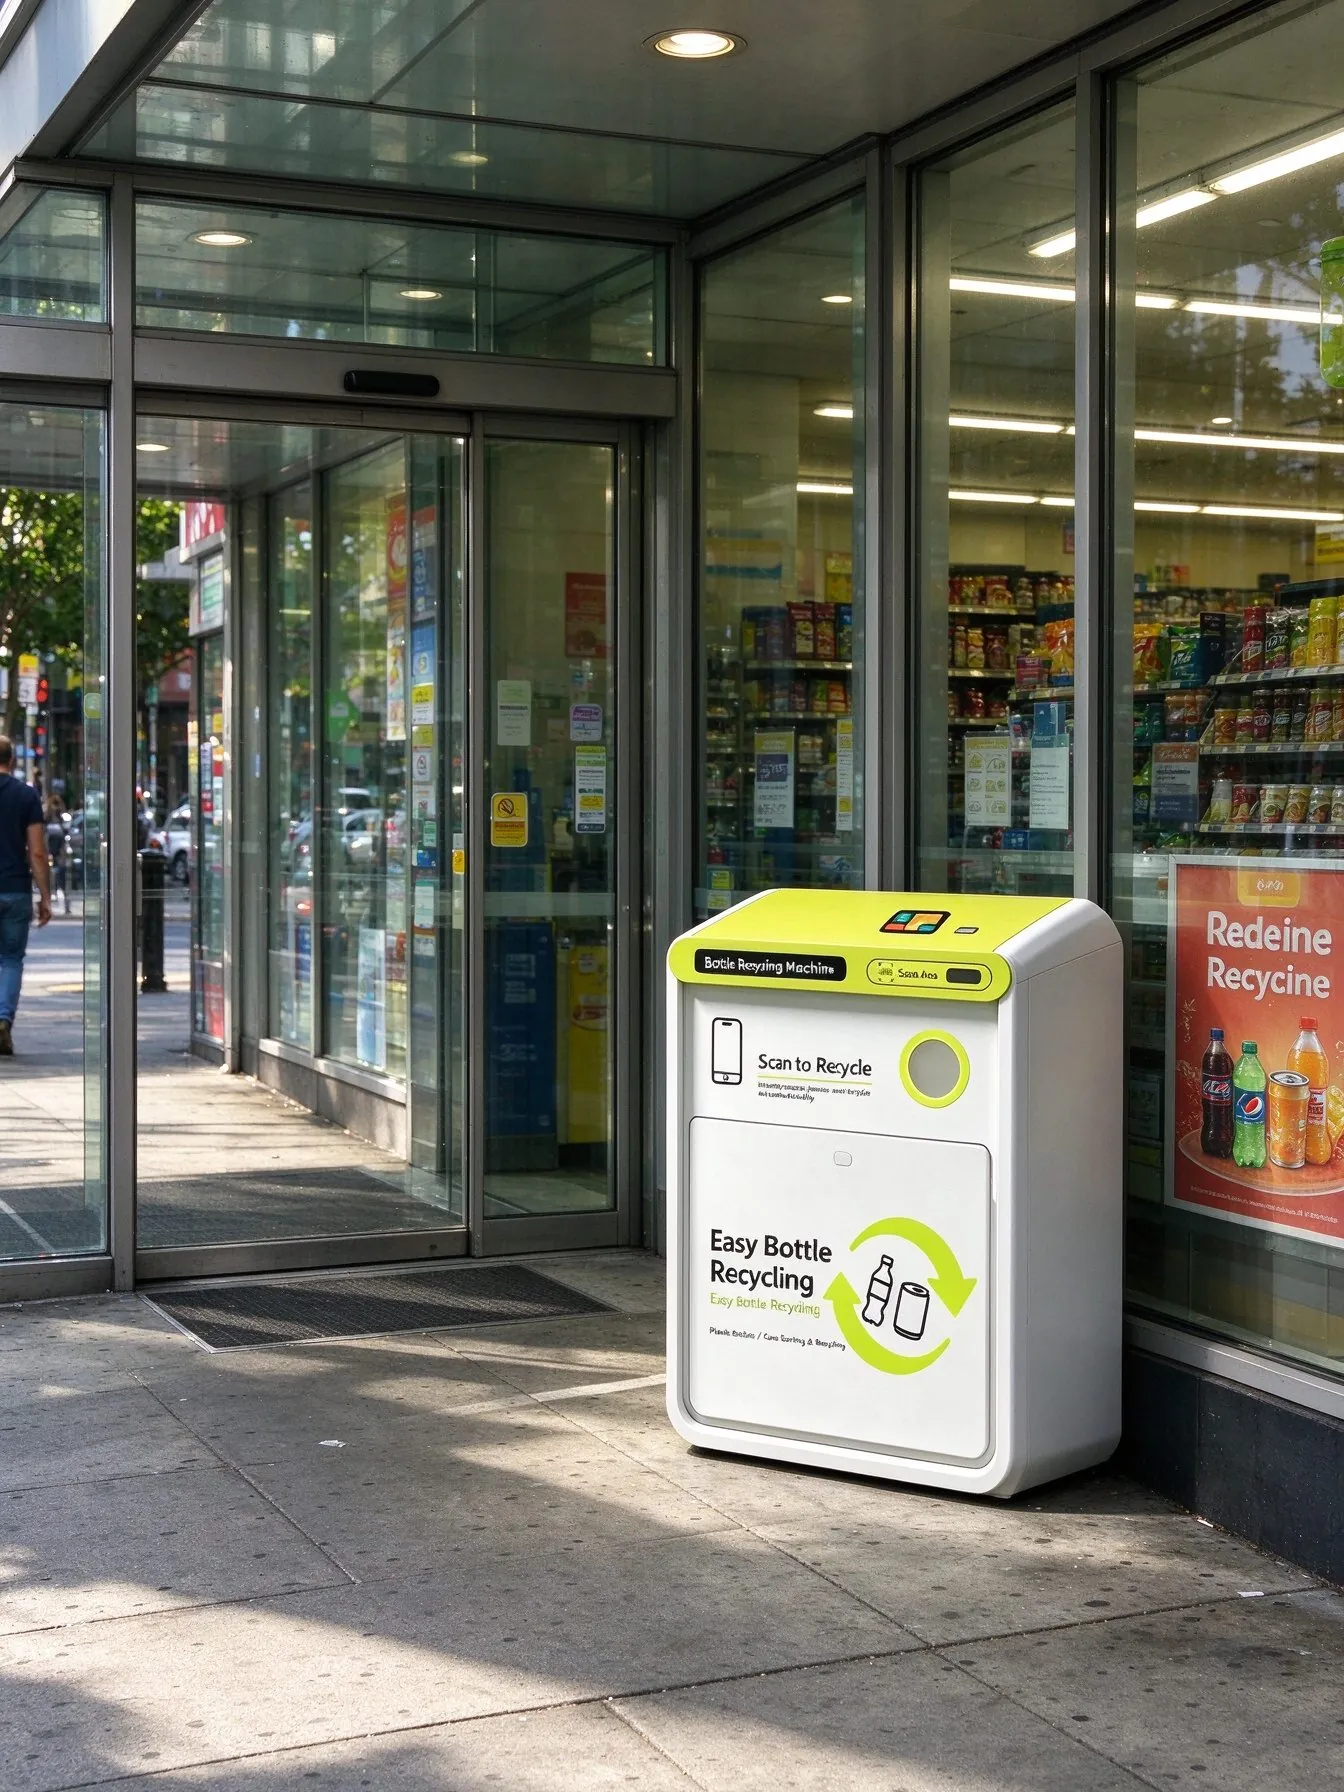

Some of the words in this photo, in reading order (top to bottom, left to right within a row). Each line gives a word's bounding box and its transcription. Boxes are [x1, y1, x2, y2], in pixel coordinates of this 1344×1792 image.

[1207, 910, 1332, 956] Redeine
[1207, 956, 1331, 1001] Recycine
[758, 1053, 792, 1070] Scan
[795, 1056, 812, 1072] to
[816, 1056, 872, 1079] Recycle
[710, 1228, 758, 1260] Easy
[764, 1234, 833, 1263] Bottle
[710, 1259, 814, 1299] Recycling
